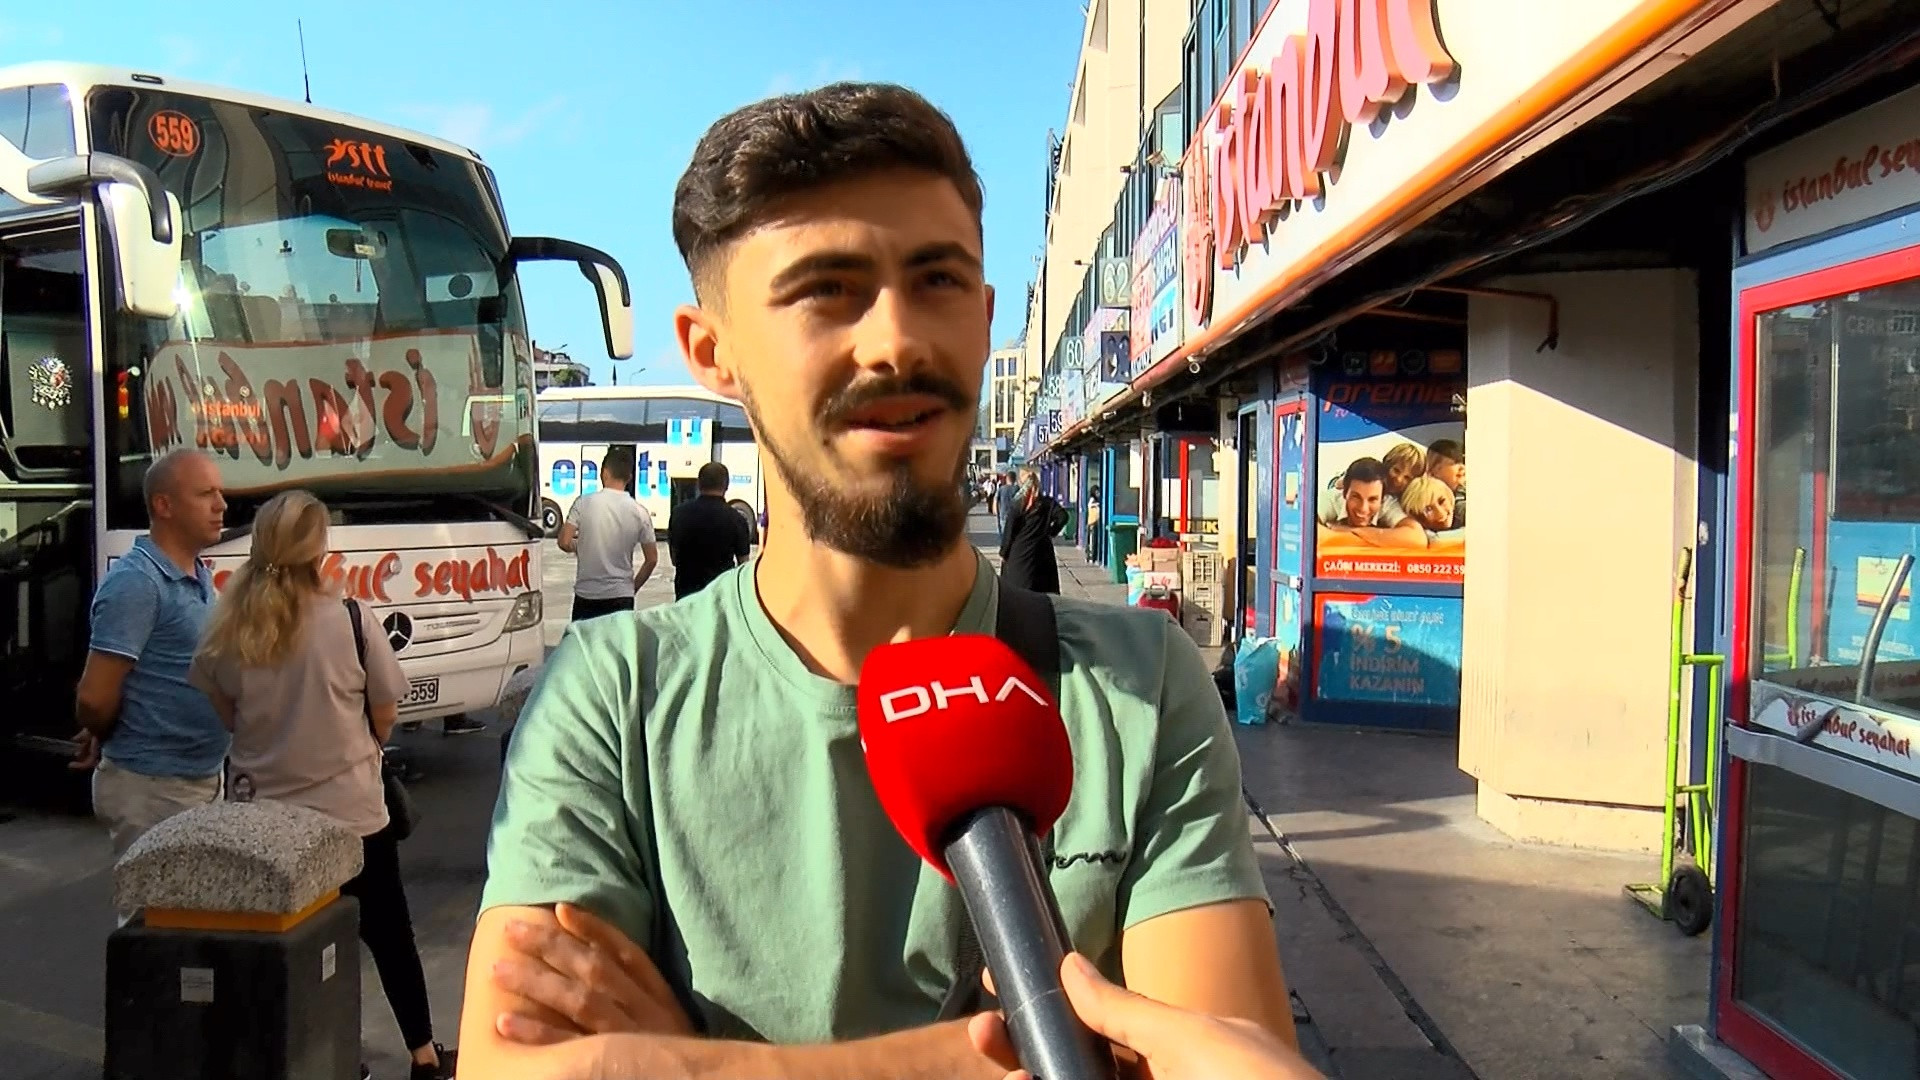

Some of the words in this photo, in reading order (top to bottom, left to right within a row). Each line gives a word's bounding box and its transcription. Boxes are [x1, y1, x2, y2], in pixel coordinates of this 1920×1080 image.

[156, 115, 193, 152] 559
[1213, 0, 1454, 270] istanbu
[1783, 144, 1878, 213] istanbul
[1103, 262, 1129, 303] 62
[1066, 339, 1083, 366] 60
[1038, 425, 1048, 443] 57
[1051, 411, 1062, 432] 59
[414, 547, 531, 602] seyahat
[1407, 563, 1432, 574] 0850
[1433, 564, 1452, 575] 222
[1385, 625, 1402, 654] 5
[880, 676, 1048, 723] DHA
[1350, 674, 1425, 695] KAZANIN
[1801, 706, 1857, 742] istnbul
[1859, 727, 1911, 759] seyahat
